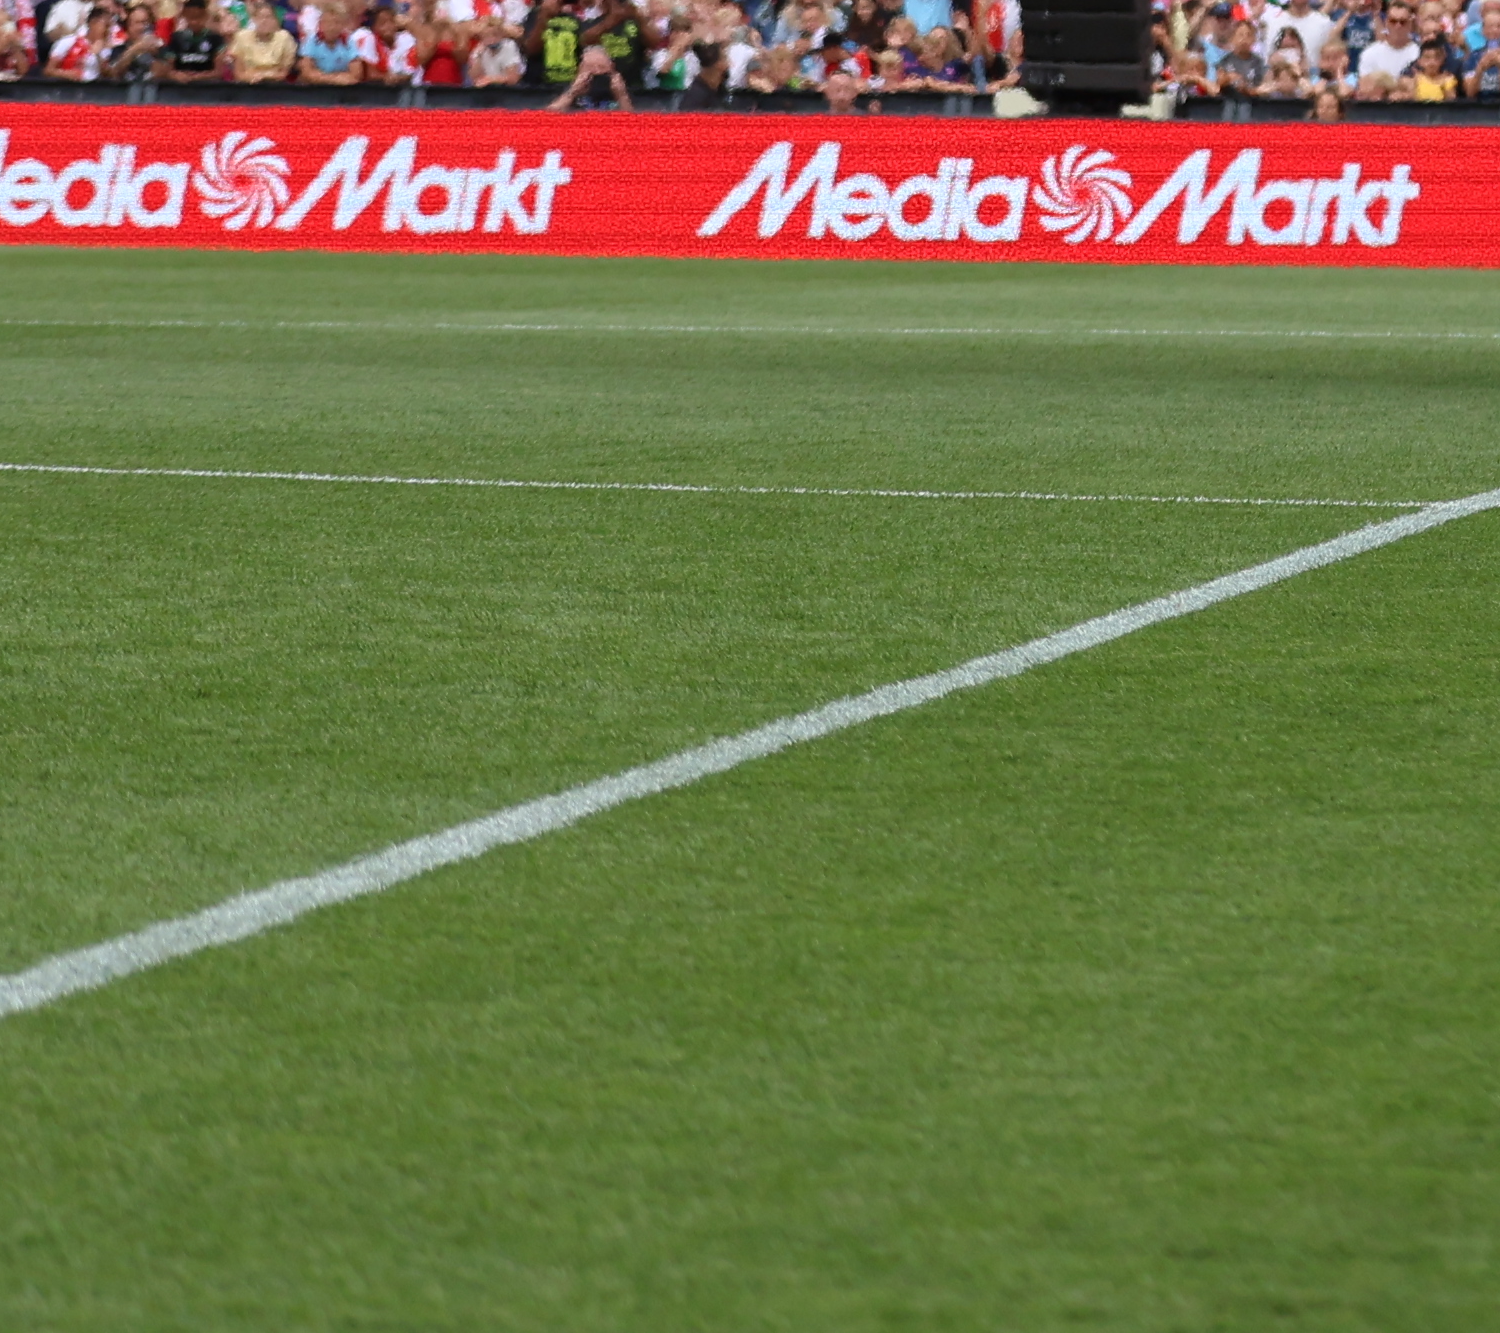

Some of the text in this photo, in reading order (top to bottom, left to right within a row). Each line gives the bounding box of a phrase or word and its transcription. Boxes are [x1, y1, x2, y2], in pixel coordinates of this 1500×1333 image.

[276, 135, 572, 234] Markt
[697, 141, 1419, 246] Media Markt
